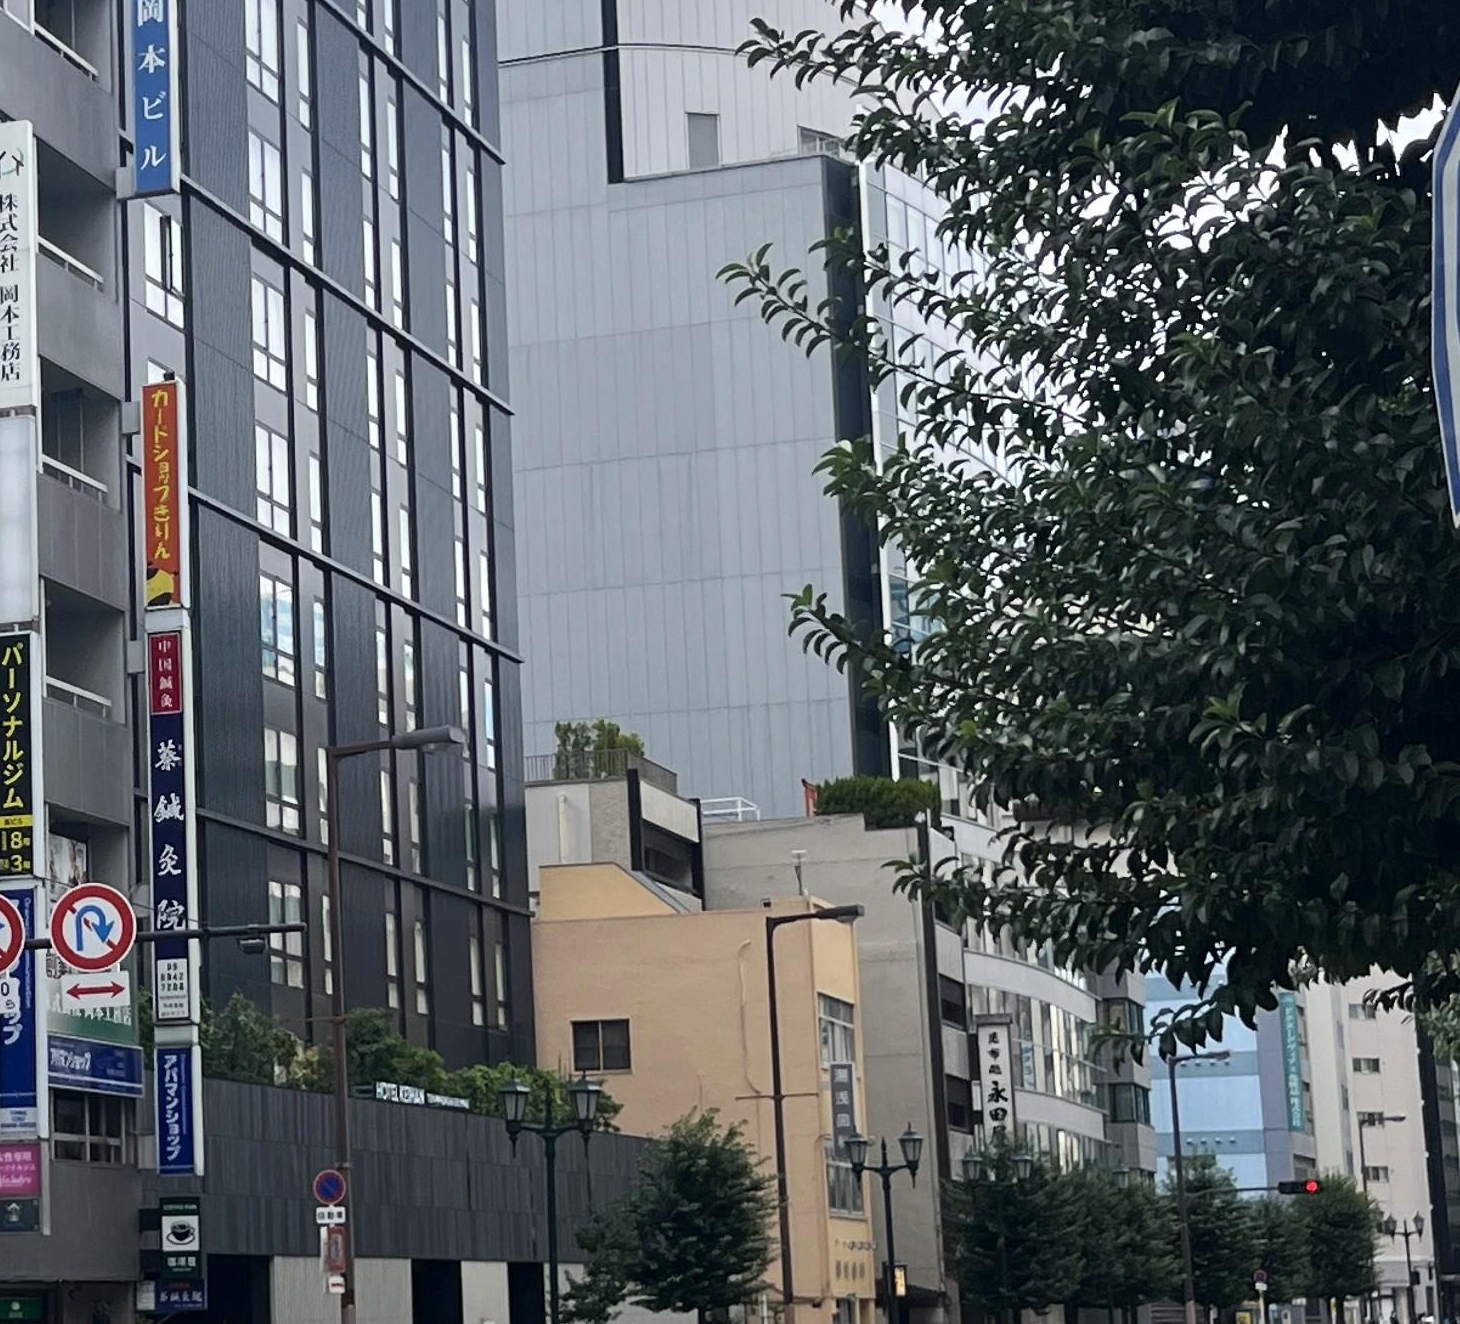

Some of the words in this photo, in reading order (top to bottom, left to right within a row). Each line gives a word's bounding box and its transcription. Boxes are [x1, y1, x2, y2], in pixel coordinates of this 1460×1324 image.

[0, 283, 21, 382] 岡本工務店
[1, 641, 25, 810] パーソナルジム
[164, 1054, 181, 1161] アパマンショップ
